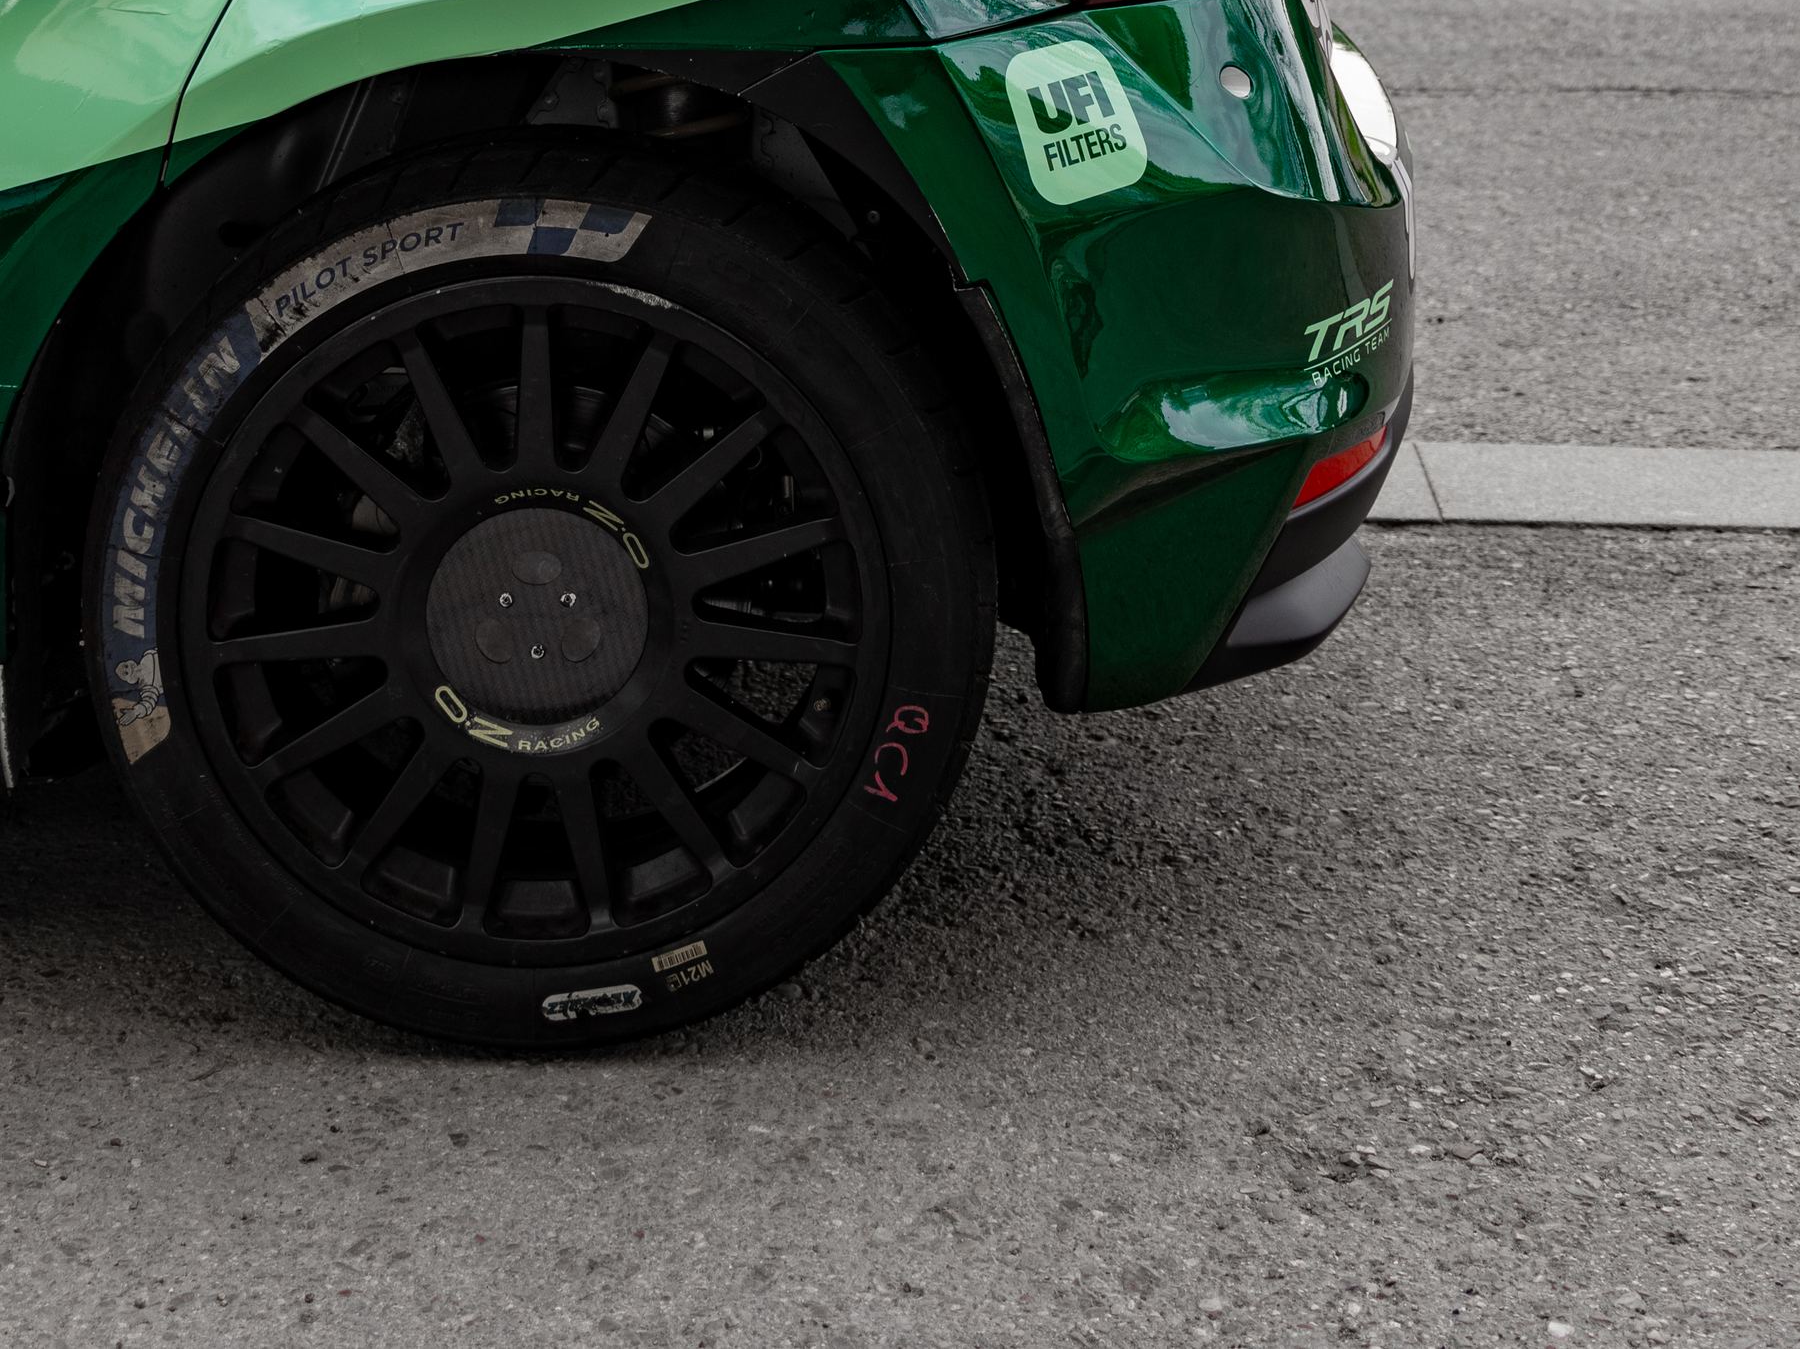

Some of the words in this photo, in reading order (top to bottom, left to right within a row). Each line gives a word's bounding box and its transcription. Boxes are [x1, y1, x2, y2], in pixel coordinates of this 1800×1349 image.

[1026, 70, 1116, 135] UFI
[1042, 123, 1128, 172] FILTERS
[274, 256, 352, 318] PILOT
[363, 222, 465, 267] SPORT
[1303, 278, 1394, 363] TRS
[1311, 348, 1362, 386] RACING
[1364, 326, 1391, 355] TEAM
[112, 335, 241, 640] MICHELIN
[494, 487, 580, 505] RACING
[518, 717, 601, 752] RACING
